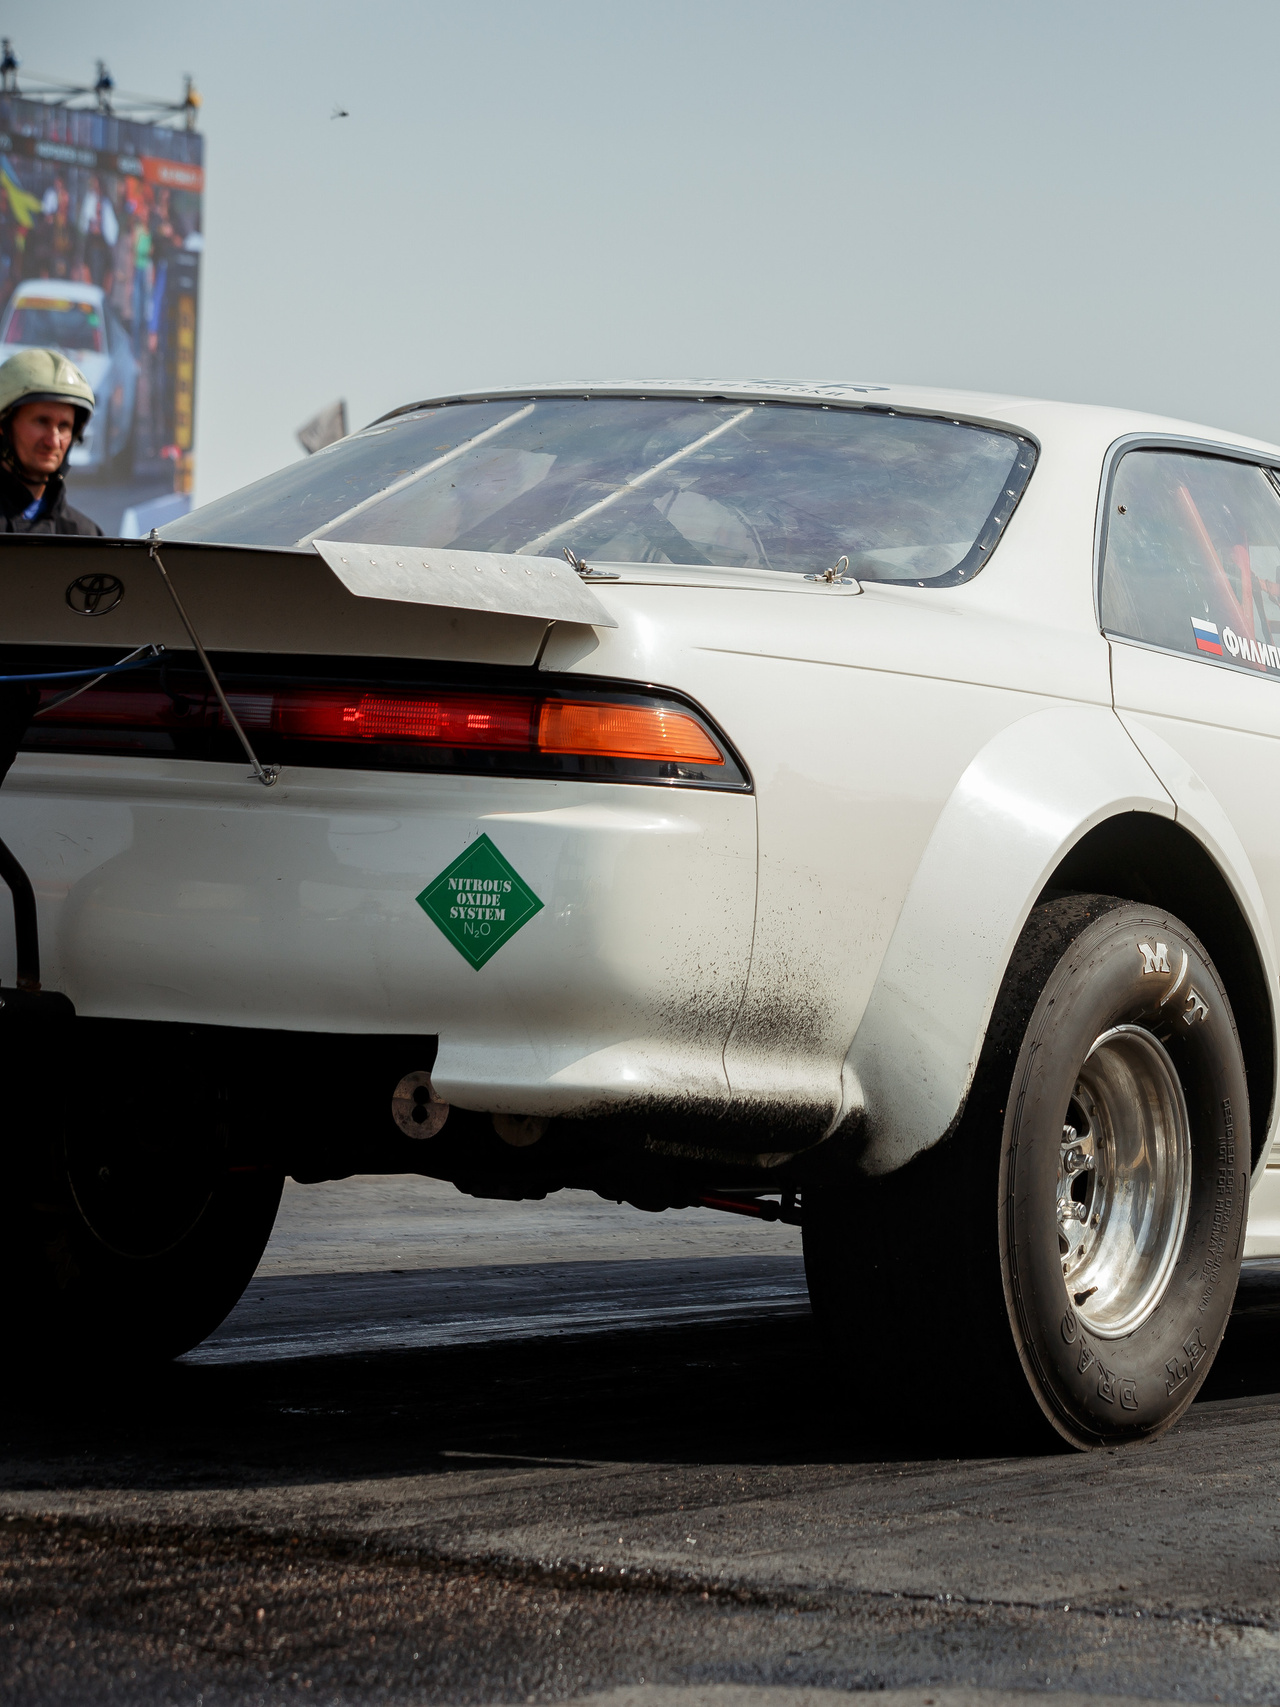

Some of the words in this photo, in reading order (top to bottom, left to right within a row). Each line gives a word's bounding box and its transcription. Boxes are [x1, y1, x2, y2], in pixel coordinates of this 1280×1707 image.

[447, 878, 512, 893] NITROUS
[456, 892, 501, 907] OXIDE
[449, 906, 506, 921] SYSTEM
[463, 921, 491, 938] N2O
[1217, 1167, 1226, 1195] FOR
[1226, 1168, 1235, 1194] FOR
[1208, 1199, 1225, 1256] HIGHWAY
[1221, 1198, 1233, 1234] DRAG
[1198, 1286, 1214, 1316] ONLY
